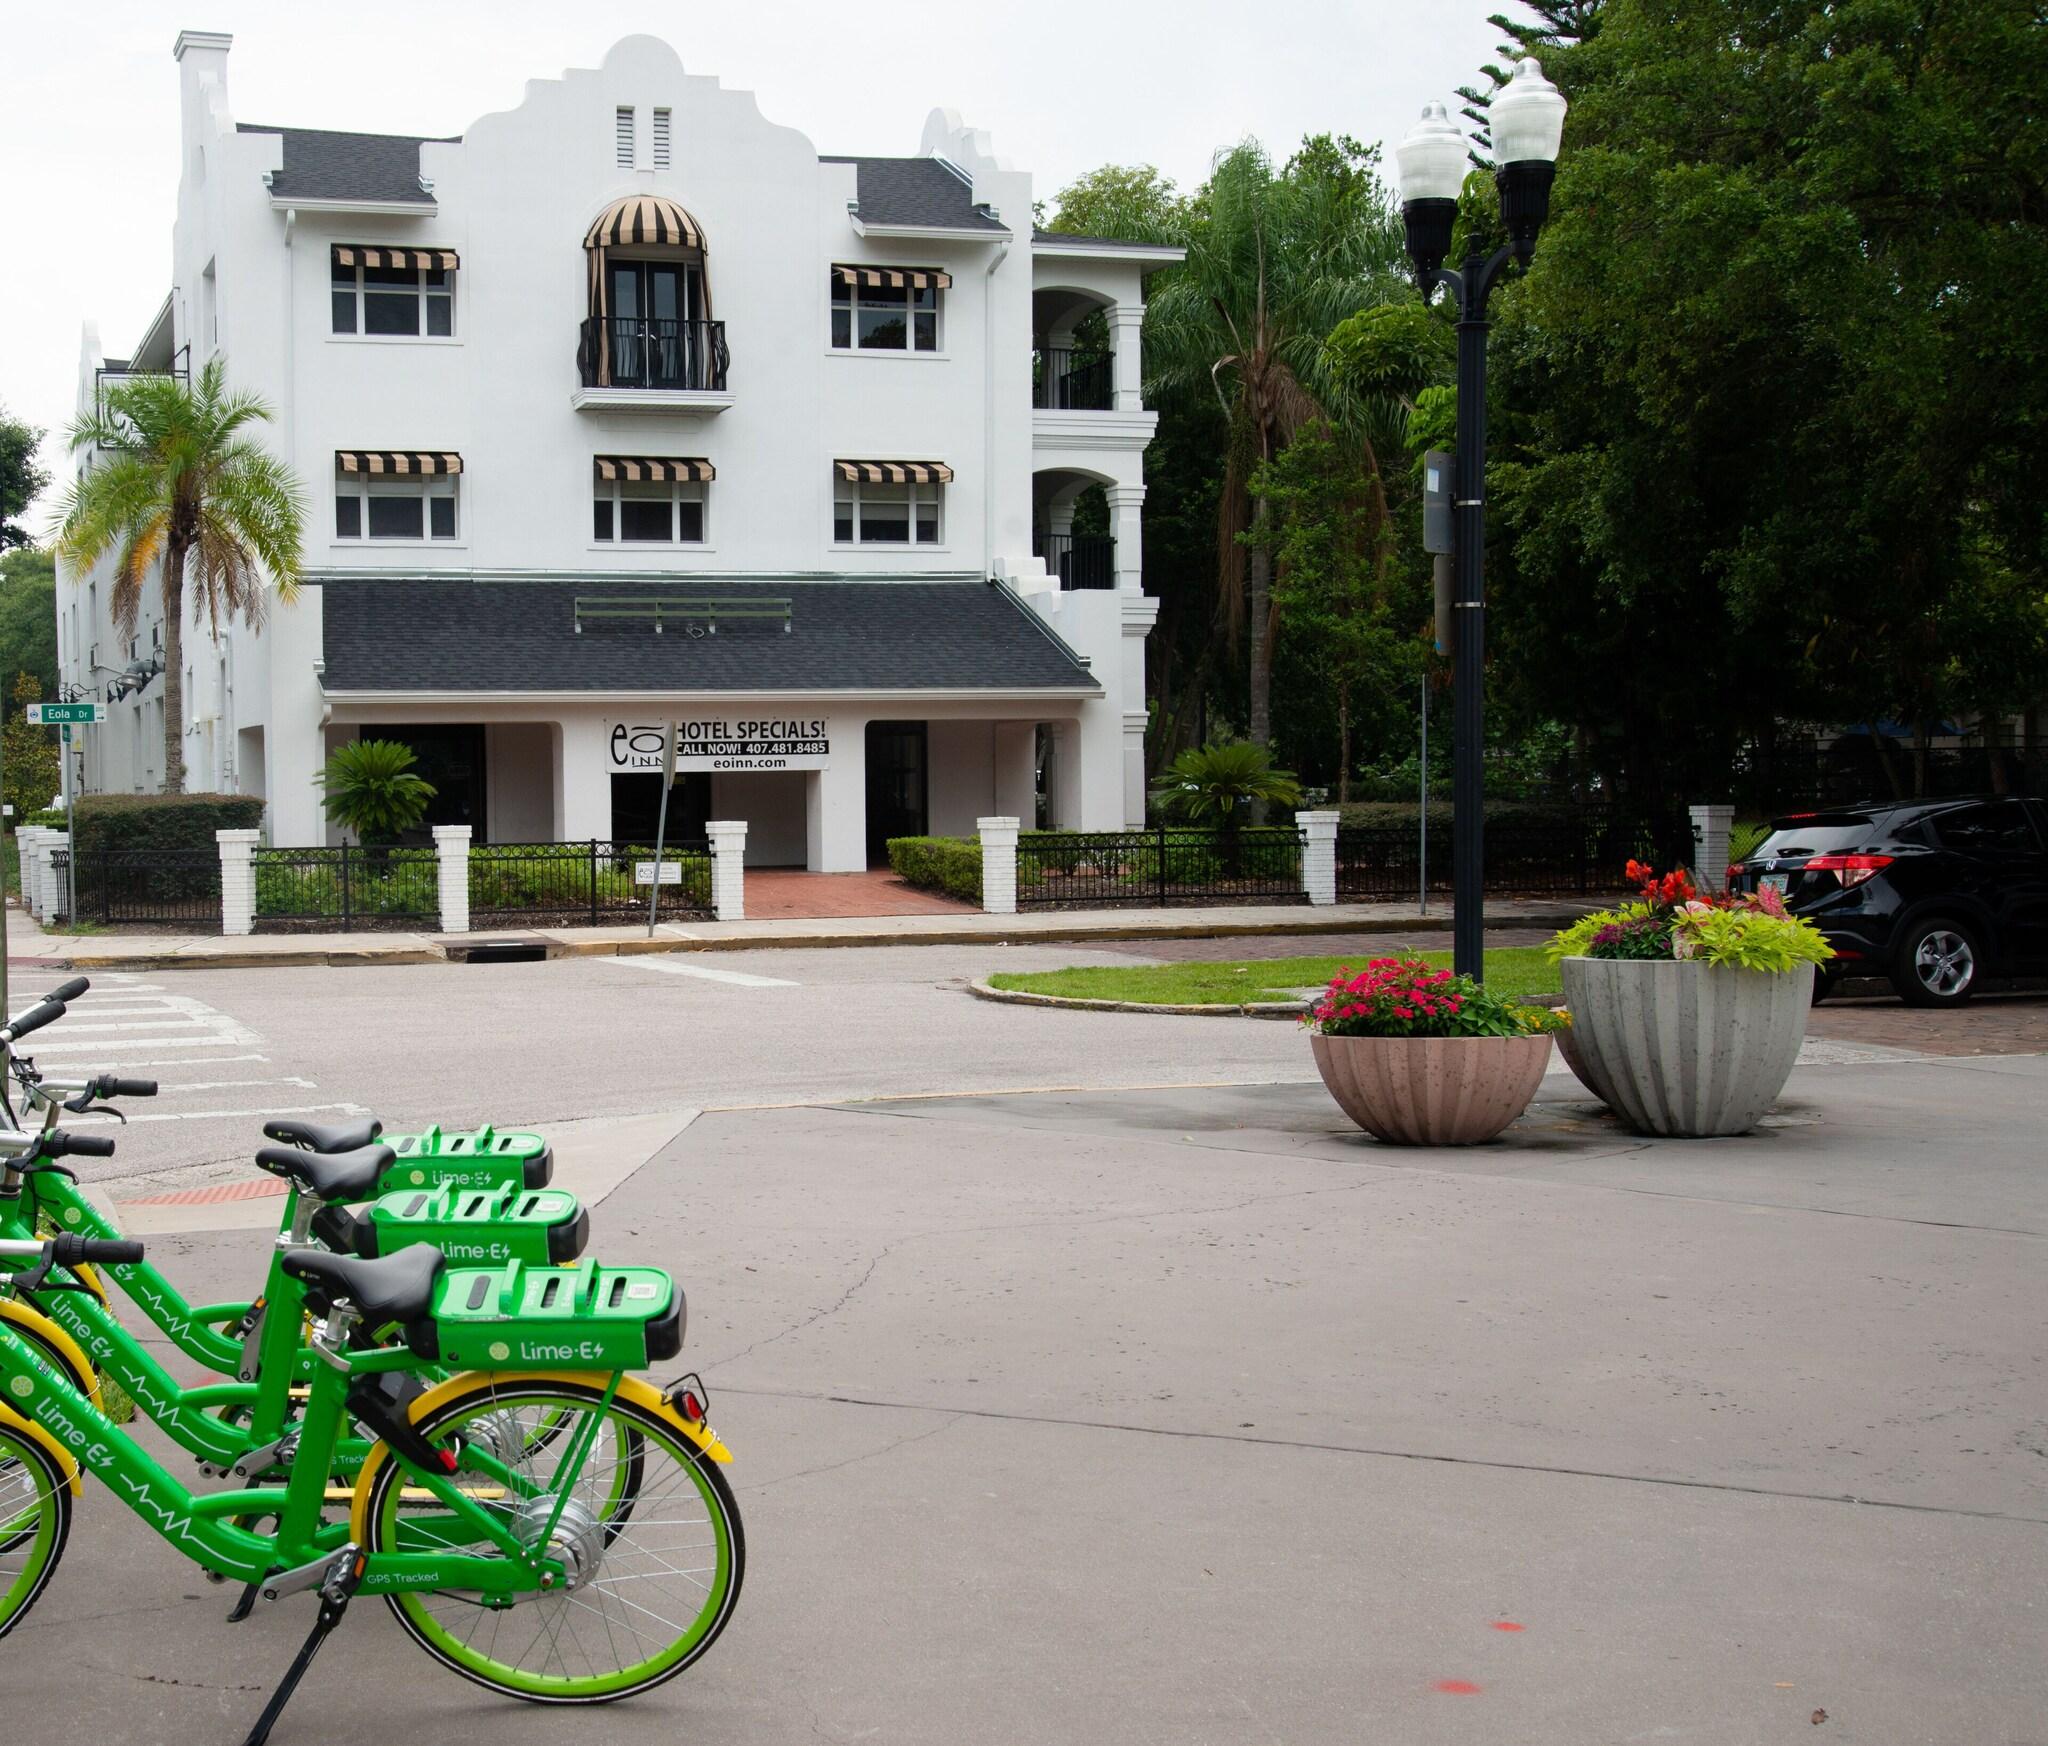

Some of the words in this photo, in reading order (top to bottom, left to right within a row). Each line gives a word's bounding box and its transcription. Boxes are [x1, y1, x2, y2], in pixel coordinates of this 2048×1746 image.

[48, 708, 71, 719] Eola
[78, 710, 88, 719] Dr
[736, 720, 826, 739] SPECIALS!
[677, 743, 706, 755] CALL
[707, 743, 741, 755] NOW!
[746, 742, 826, 754] 407.481.8485
[713, 757, 787, 769] eoinn.com
[366, 1574, 391, 1585] GPS
[394, 1572, 439, 1584] Tracked
